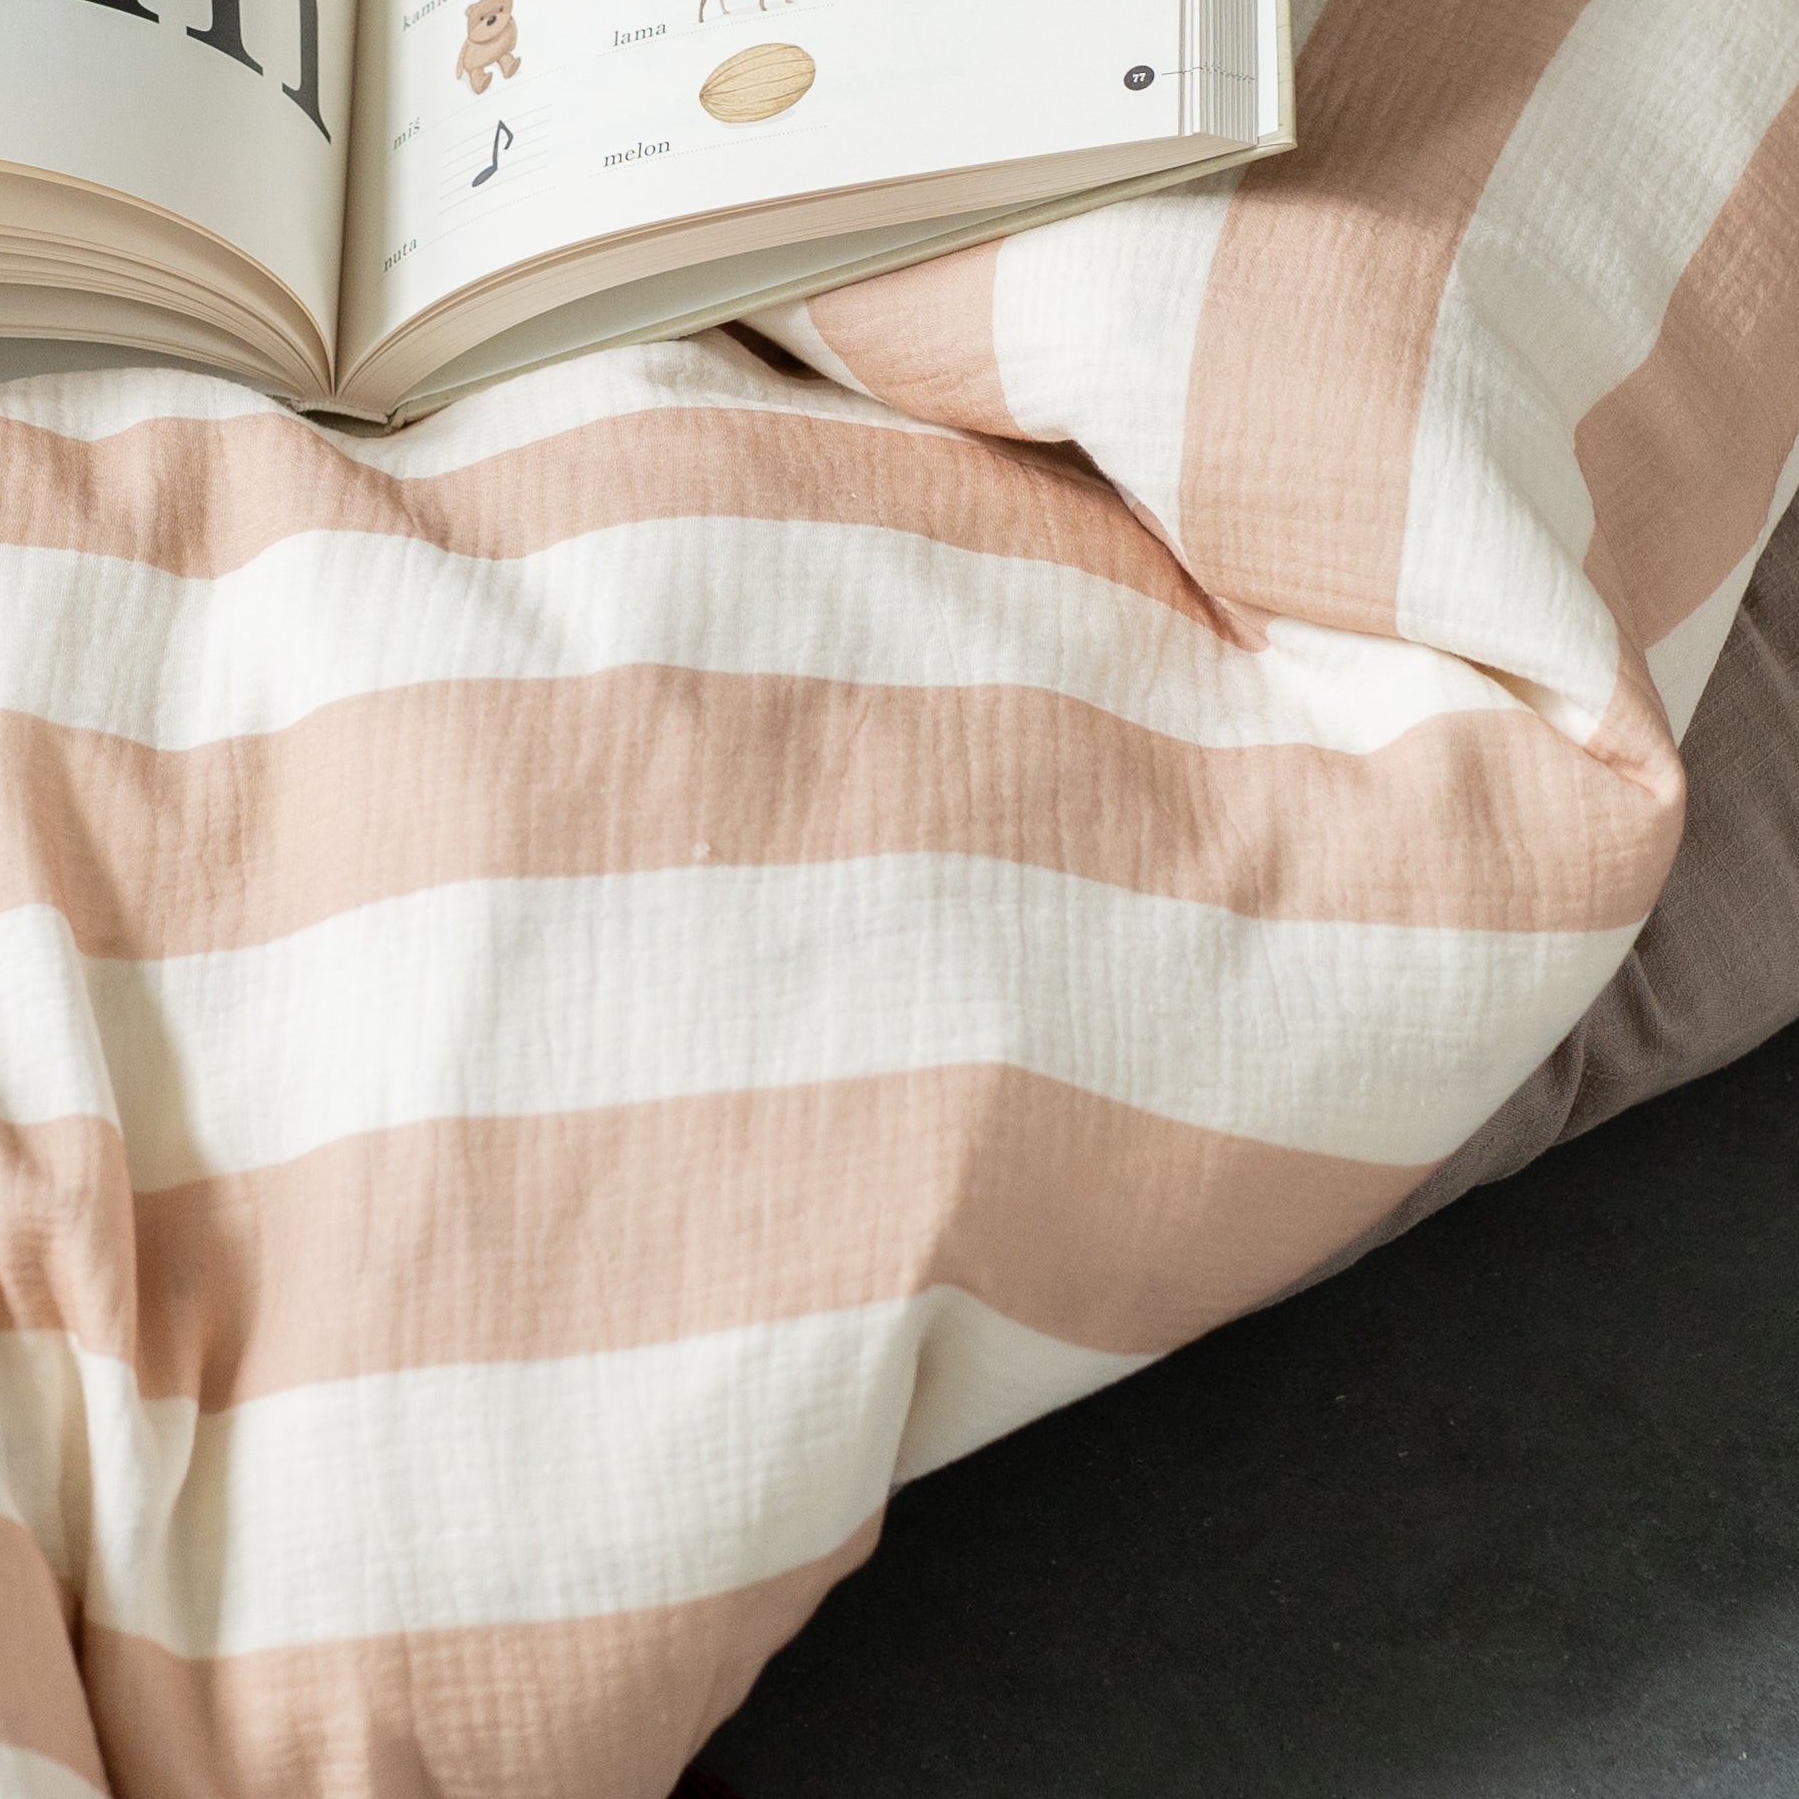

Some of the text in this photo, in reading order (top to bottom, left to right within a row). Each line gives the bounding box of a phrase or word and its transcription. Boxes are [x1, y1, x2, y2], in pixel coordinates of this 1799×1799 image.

[612, 22, 668, 48] lama
[1132, 72, 1146, 83] 77
[393, 117, 421, 151] miś
[603, 140, 672, 168] melon
[383, 237, 418, 272] nuta
